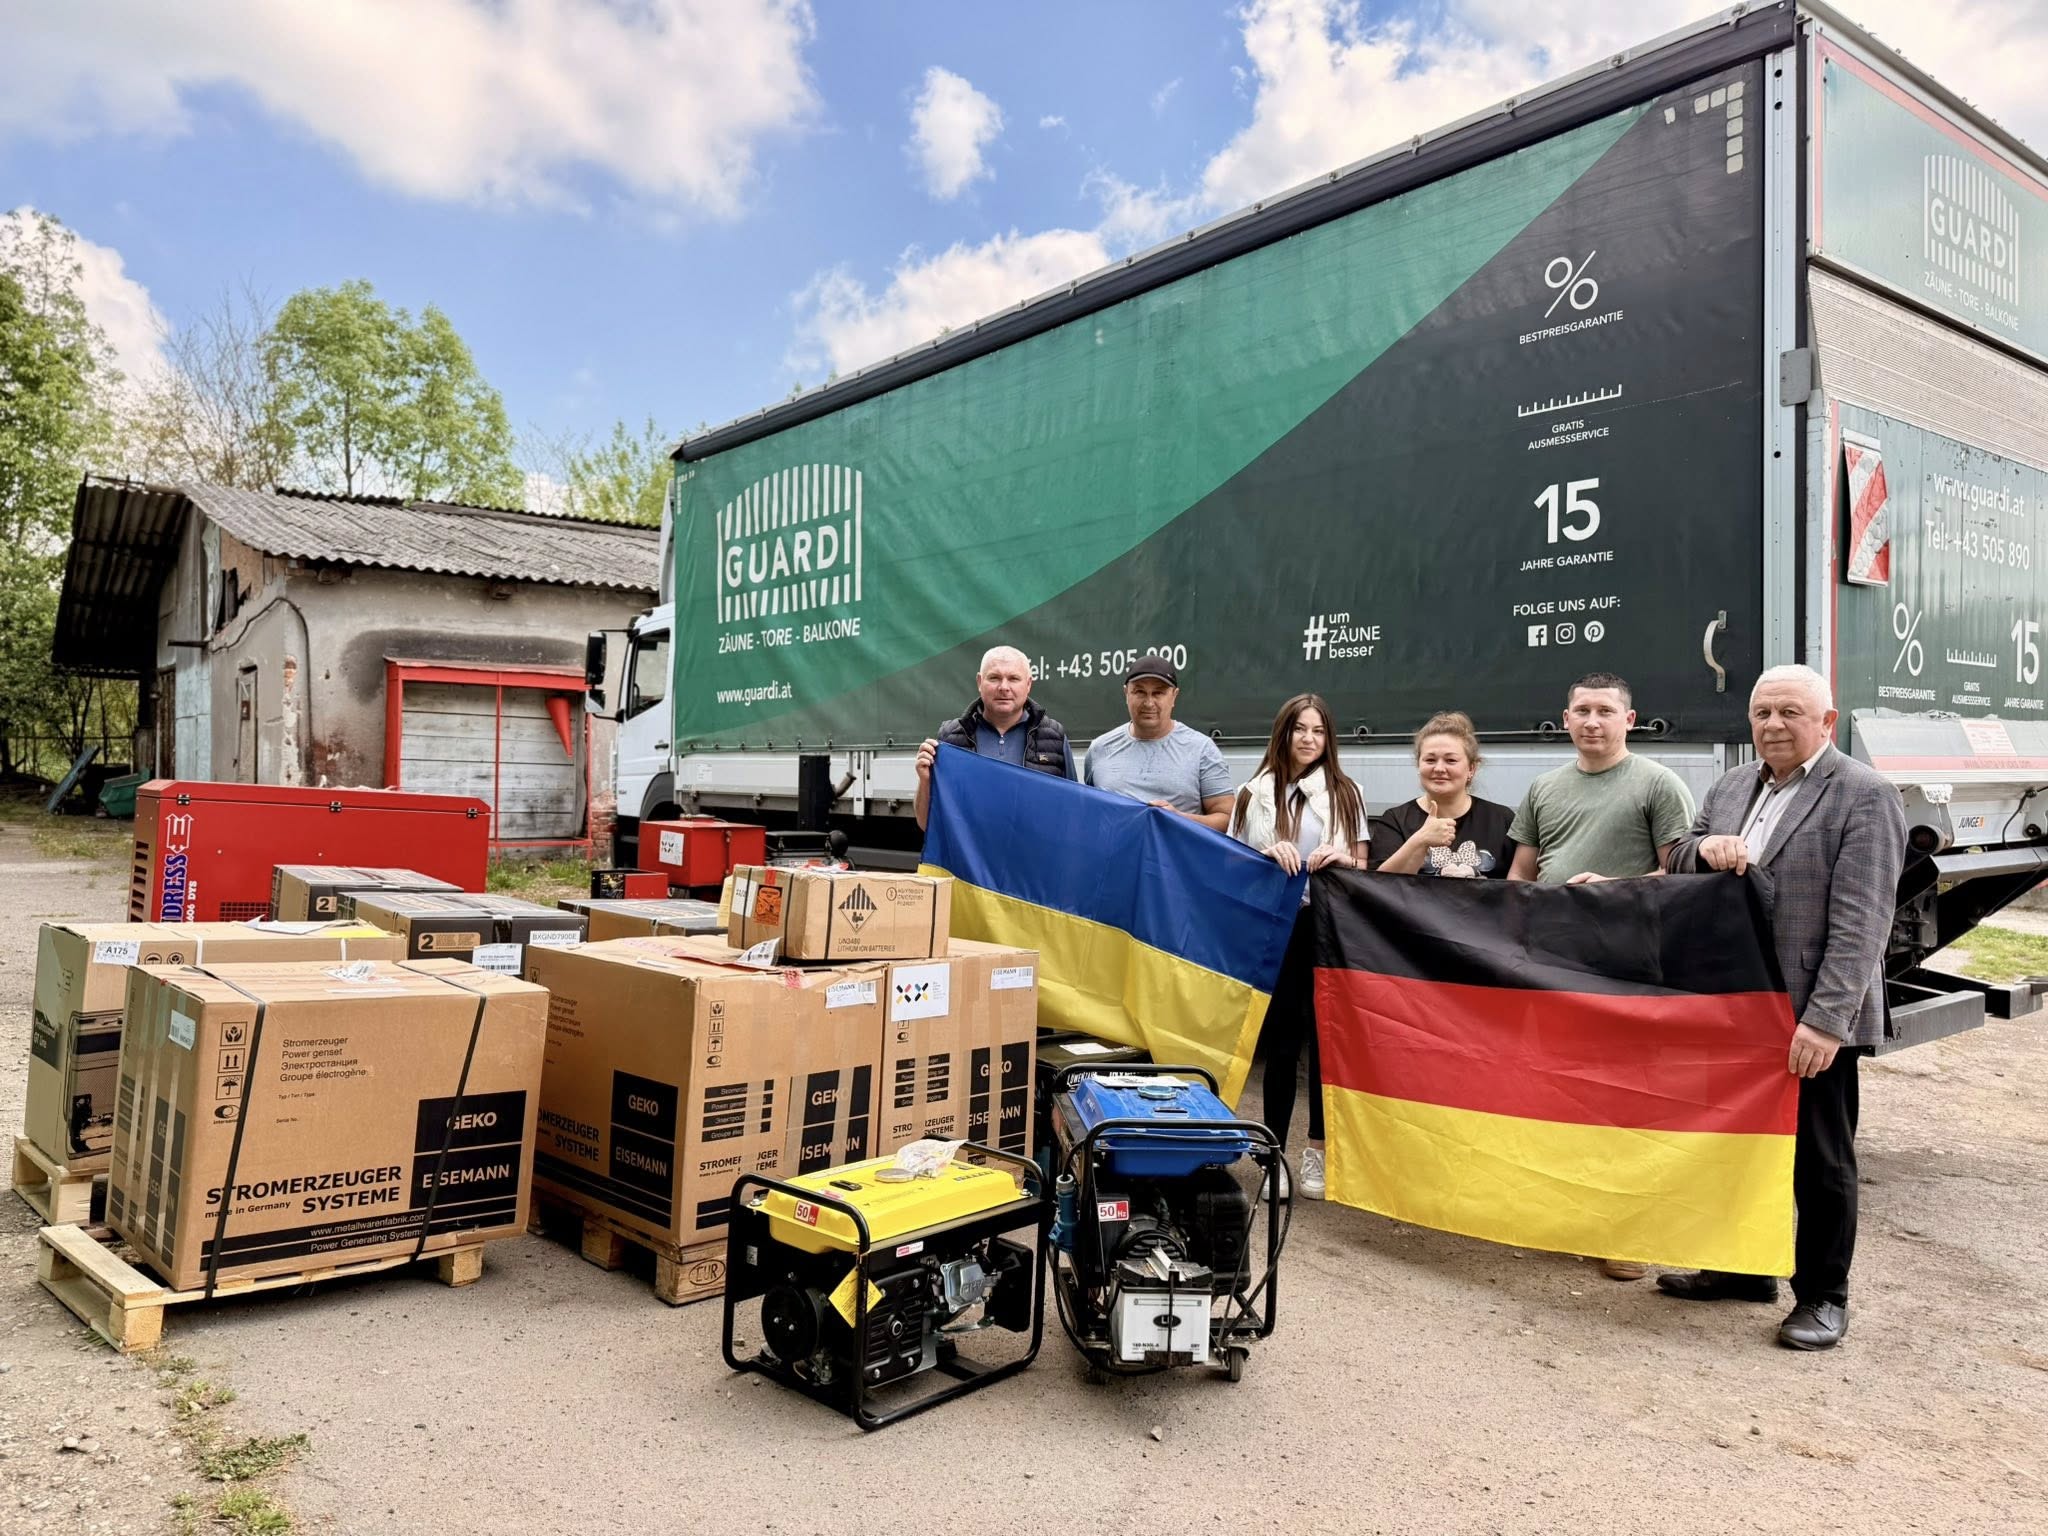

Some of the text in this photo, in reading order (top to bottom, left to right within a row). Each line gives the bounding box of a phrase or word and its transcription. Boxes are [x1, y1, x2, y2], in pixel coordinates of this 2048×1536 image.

[1931, 197, 2013, 275] GUARDI
[1924, 271, 1952, 298] ZÄUNE
[1958, 288, 1980, 311] TORE
[1985, 302, 2019, 331] BALKONE
[1519, 310, 1624, 345] BESTPREISGARANTIE
[1552, 419, 1585, 434] GRATIS
[1528, 427, 1610, 451] AUSMESSSERVICE
[1933, 473, 2025, 518] www.guardi.at
[1533, 477, 1601, 544] 15
[725, 519, 851, 588] GUARDI
[1925, 519, 2030, 571] Tel: +43 505 890
[1520, 551, 1614, 571] JAHRE GARANTIE
[1513, 596, 1621, 617] FOLGE UNS AUF:
[1329, 612, 1350, 624] um
[718, 632, 754, 655] ZÄUNE
[762, 628, 793, 648] TORE
[803, 617, 861, 643] BALKONE
[1329, 625, 1381, 644] ZÄUNE
[1329, 644, 1374, 659] besser
[2010, 619, 2040, 685] 15
[1029, 656, 1050, 681] el:
[1057, 653, 1093, 678] +43
[717, 680, 792, 706] www.guardi.at
[1878, 686, 1936, 701] BESTPREISGARANTIE
[1963, 681, 1981, 692] GRATIS
[2004, 697, 2020, 709] JAHRE
[318, 898, 329, 911] 2
[106, 946, 128, 955] A175
[420, 934, 434, 949] 2
[282, 1036, 348, 1048] Stromerzeuger
[281, 1058, 358, 1071] Электростанция
[282, 1049, 343, 1060] Power genset
[279, 1068, 367, 1083] Groupe électrogène
[980, 1060, 1012, 1077] GKO
[628, 1094, 659, 1117] GEKO
[968, 1105, 1021, 1127] EISEANN
[555, 1134, 600, 1162] SYSTEME
[615, 1146, 667, 1177] EISEMANN
[422, 1163, 510, 1189] ESEMANN
[205, 1201, 291, 1219] mae in Germany
[302, 1186, 400, 1214] SYSTEME
[796, 1204, 809, 1218] 50
[1100, 1205, 1127, 1218] 50 Hz
[310, 1228, 423, 1254] Power Generating System
[695, 1263, 718, 1282] EUR
